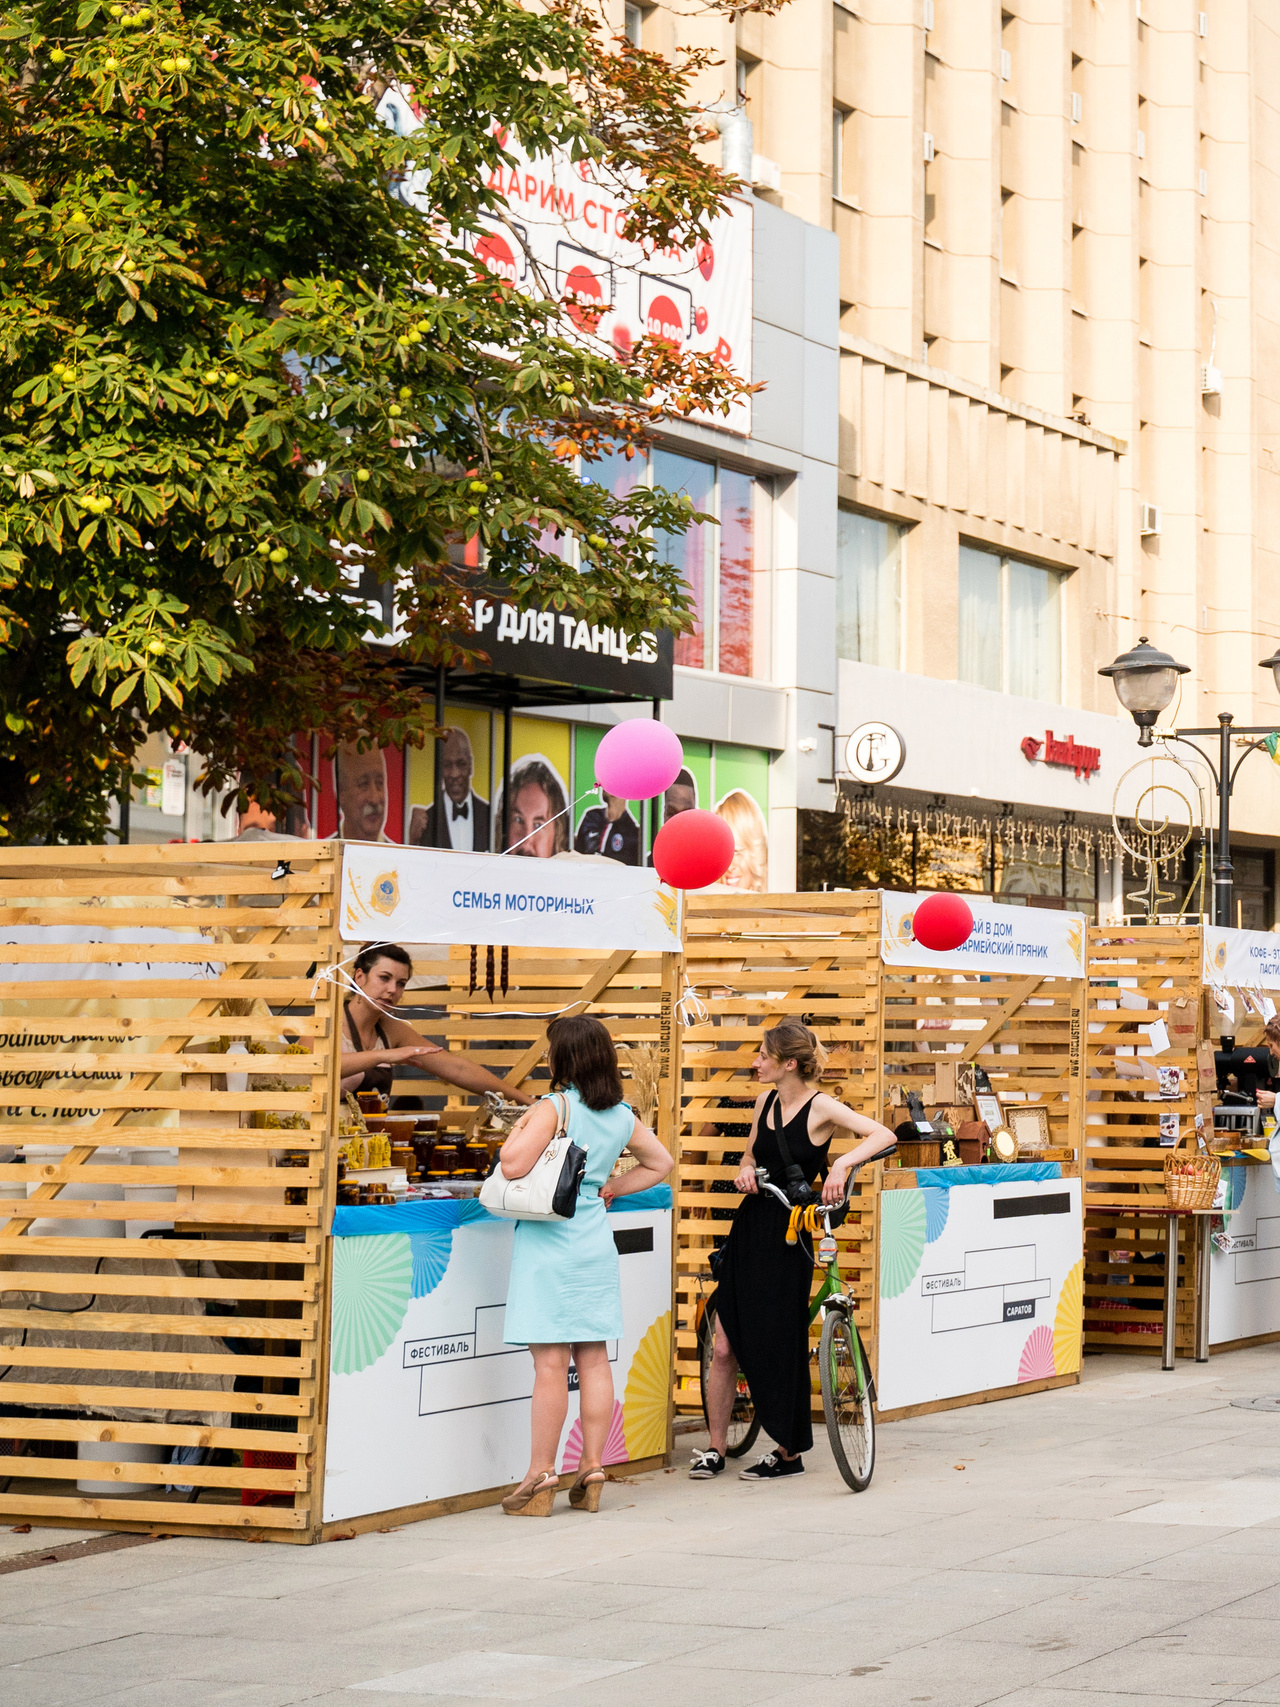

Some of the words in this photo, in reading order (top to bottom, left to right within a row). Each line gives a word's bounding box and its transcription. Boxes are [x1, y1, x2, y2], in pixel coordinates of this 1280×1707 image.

[486, 164, 575, 220] ДАРИМ
[647, 316, 662, 335] 10
[662, 321, 684, 343] 000
[497, 602, 555, 645] ДЛЯ
[452, 889, 501, 910] СЕМЬЯ
[505, 892, 594, 915] МОТОРИНЫХ
[985, 922, 991, 935] В
[993, 922, 1013, 937] ДОМ
[1016, 943, 1048, 959] ПРЯНИК
[1249, 946, 1267, 959] КОФЕ
[659, 991, 672, 1079] WWW.SMCLUSTER.RU
[925, 1278, 961, 1290] ФЕСТИВАЛЬ
[1006, 1304, 1033, 1317] САРАТОВ
[410, 1341, 469, 1360] ФЕСТИВАЛЬ
